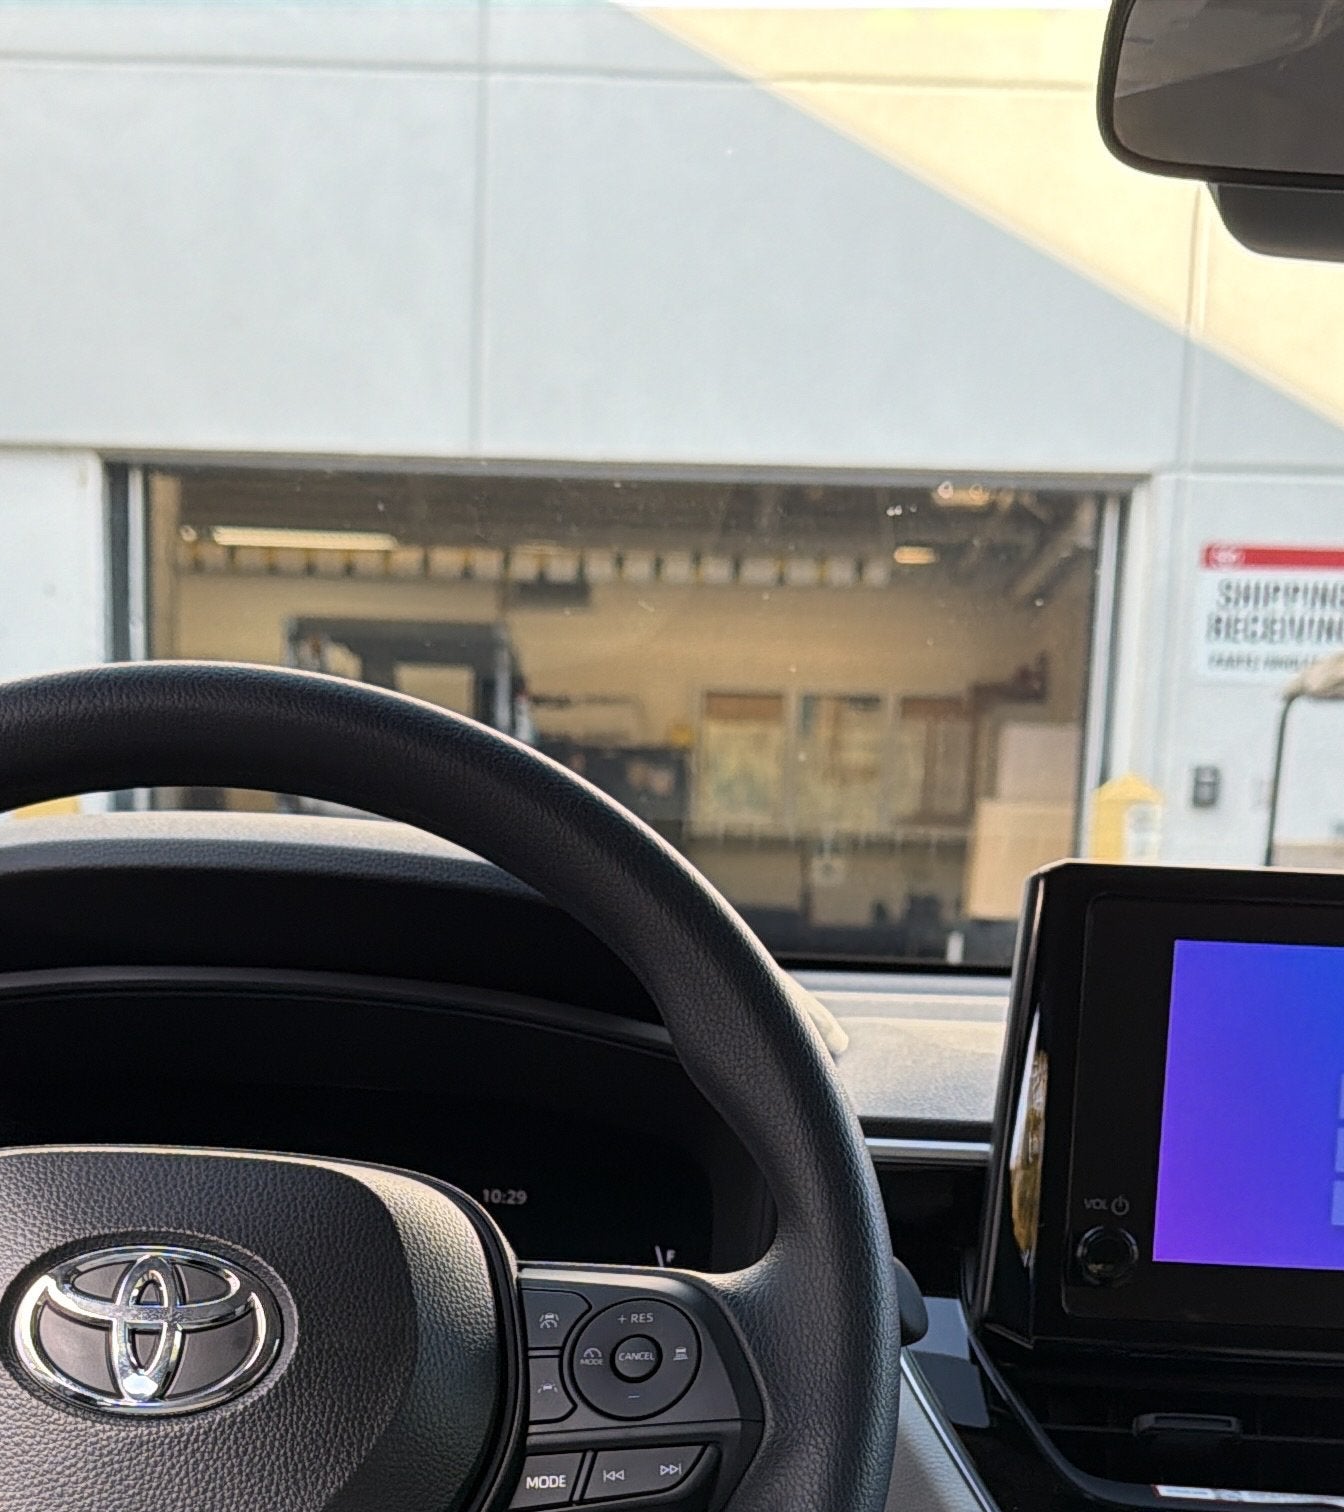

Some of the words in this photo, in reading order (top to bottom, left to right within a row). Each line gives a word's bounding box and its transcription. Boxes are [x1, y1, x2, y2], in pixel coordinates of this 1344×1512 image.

[482, 1188, 528, 1206] 10:29
[1084, 1198, 1108, 1210] VOL
[630, 1312, 654, 1324] RES
[579, 1358, 604, 1366] MODE
[618, 1351, 655, 1362] CANCEL
[525, 1474, 568, 1490] MODE
